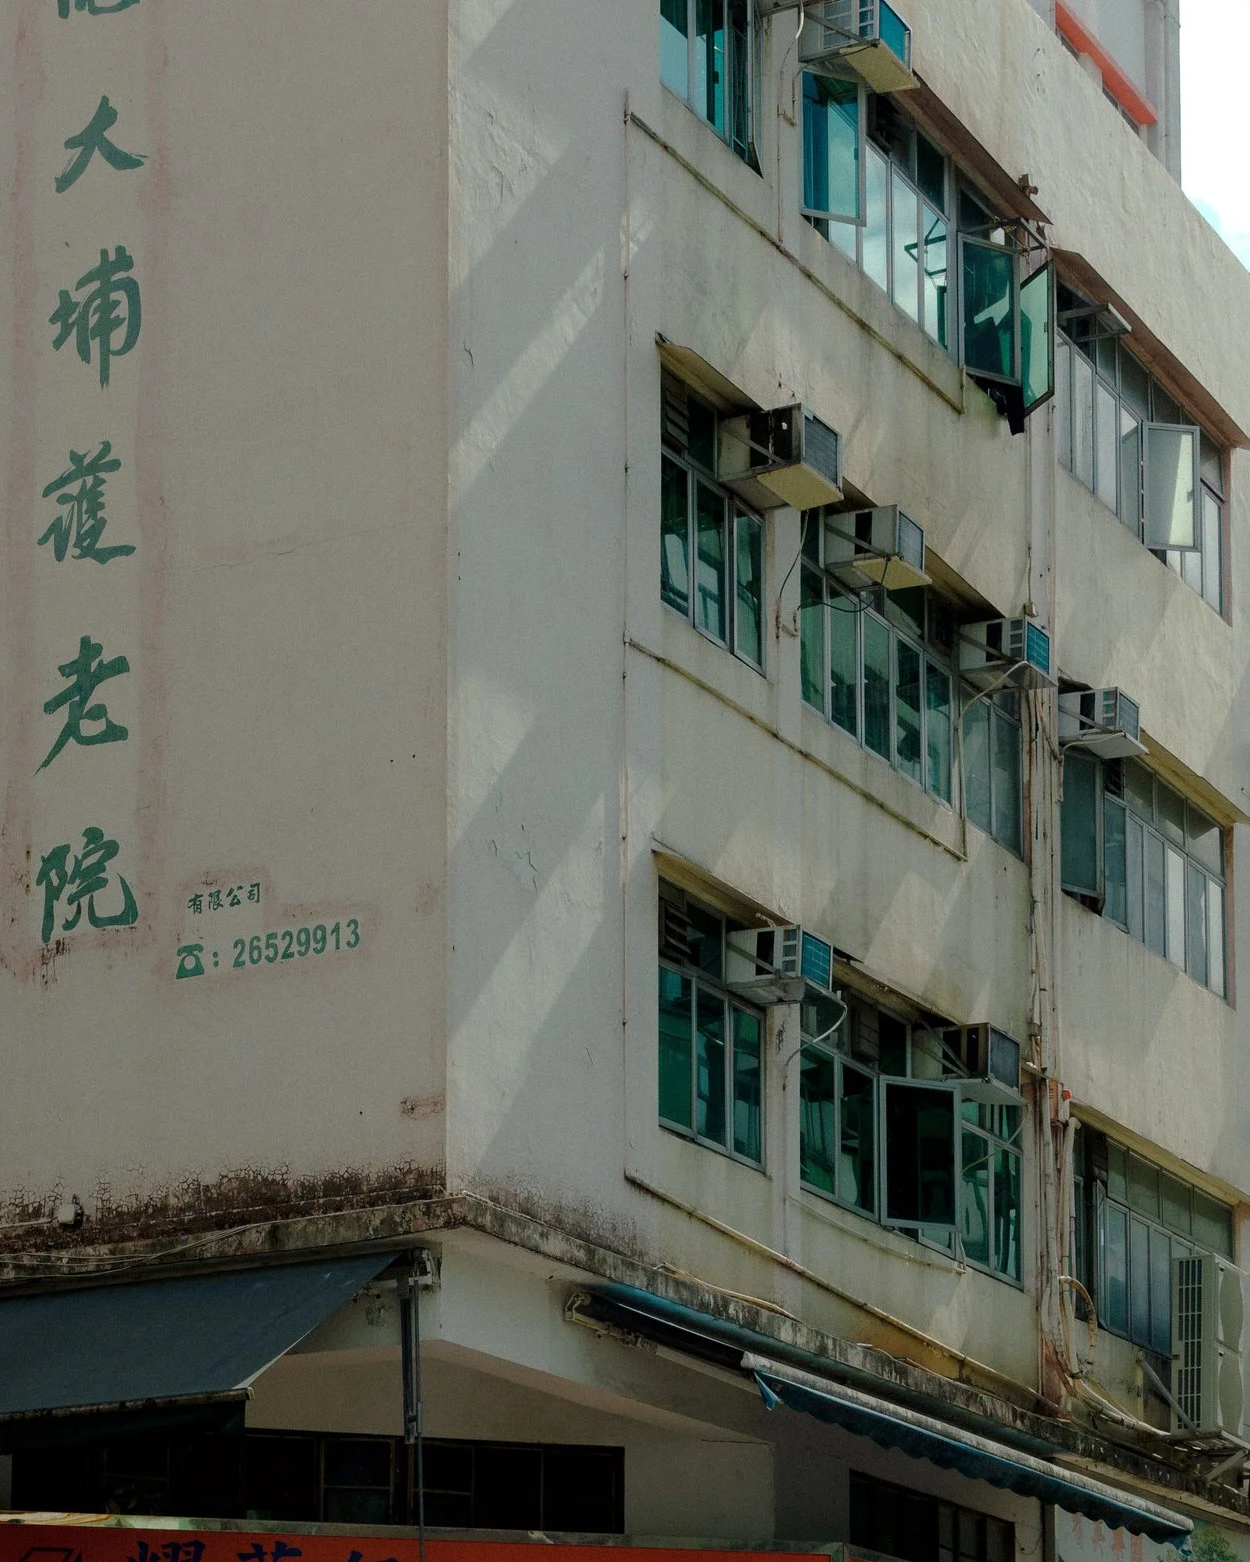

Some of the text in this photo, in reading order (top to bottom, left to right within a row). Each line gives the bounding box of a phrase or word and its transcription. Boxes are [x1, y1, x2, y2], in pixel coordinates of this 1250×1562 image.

[34, 0, 150, 943] 大埔護老院
[187, 882, 261, 914] 有限公司
